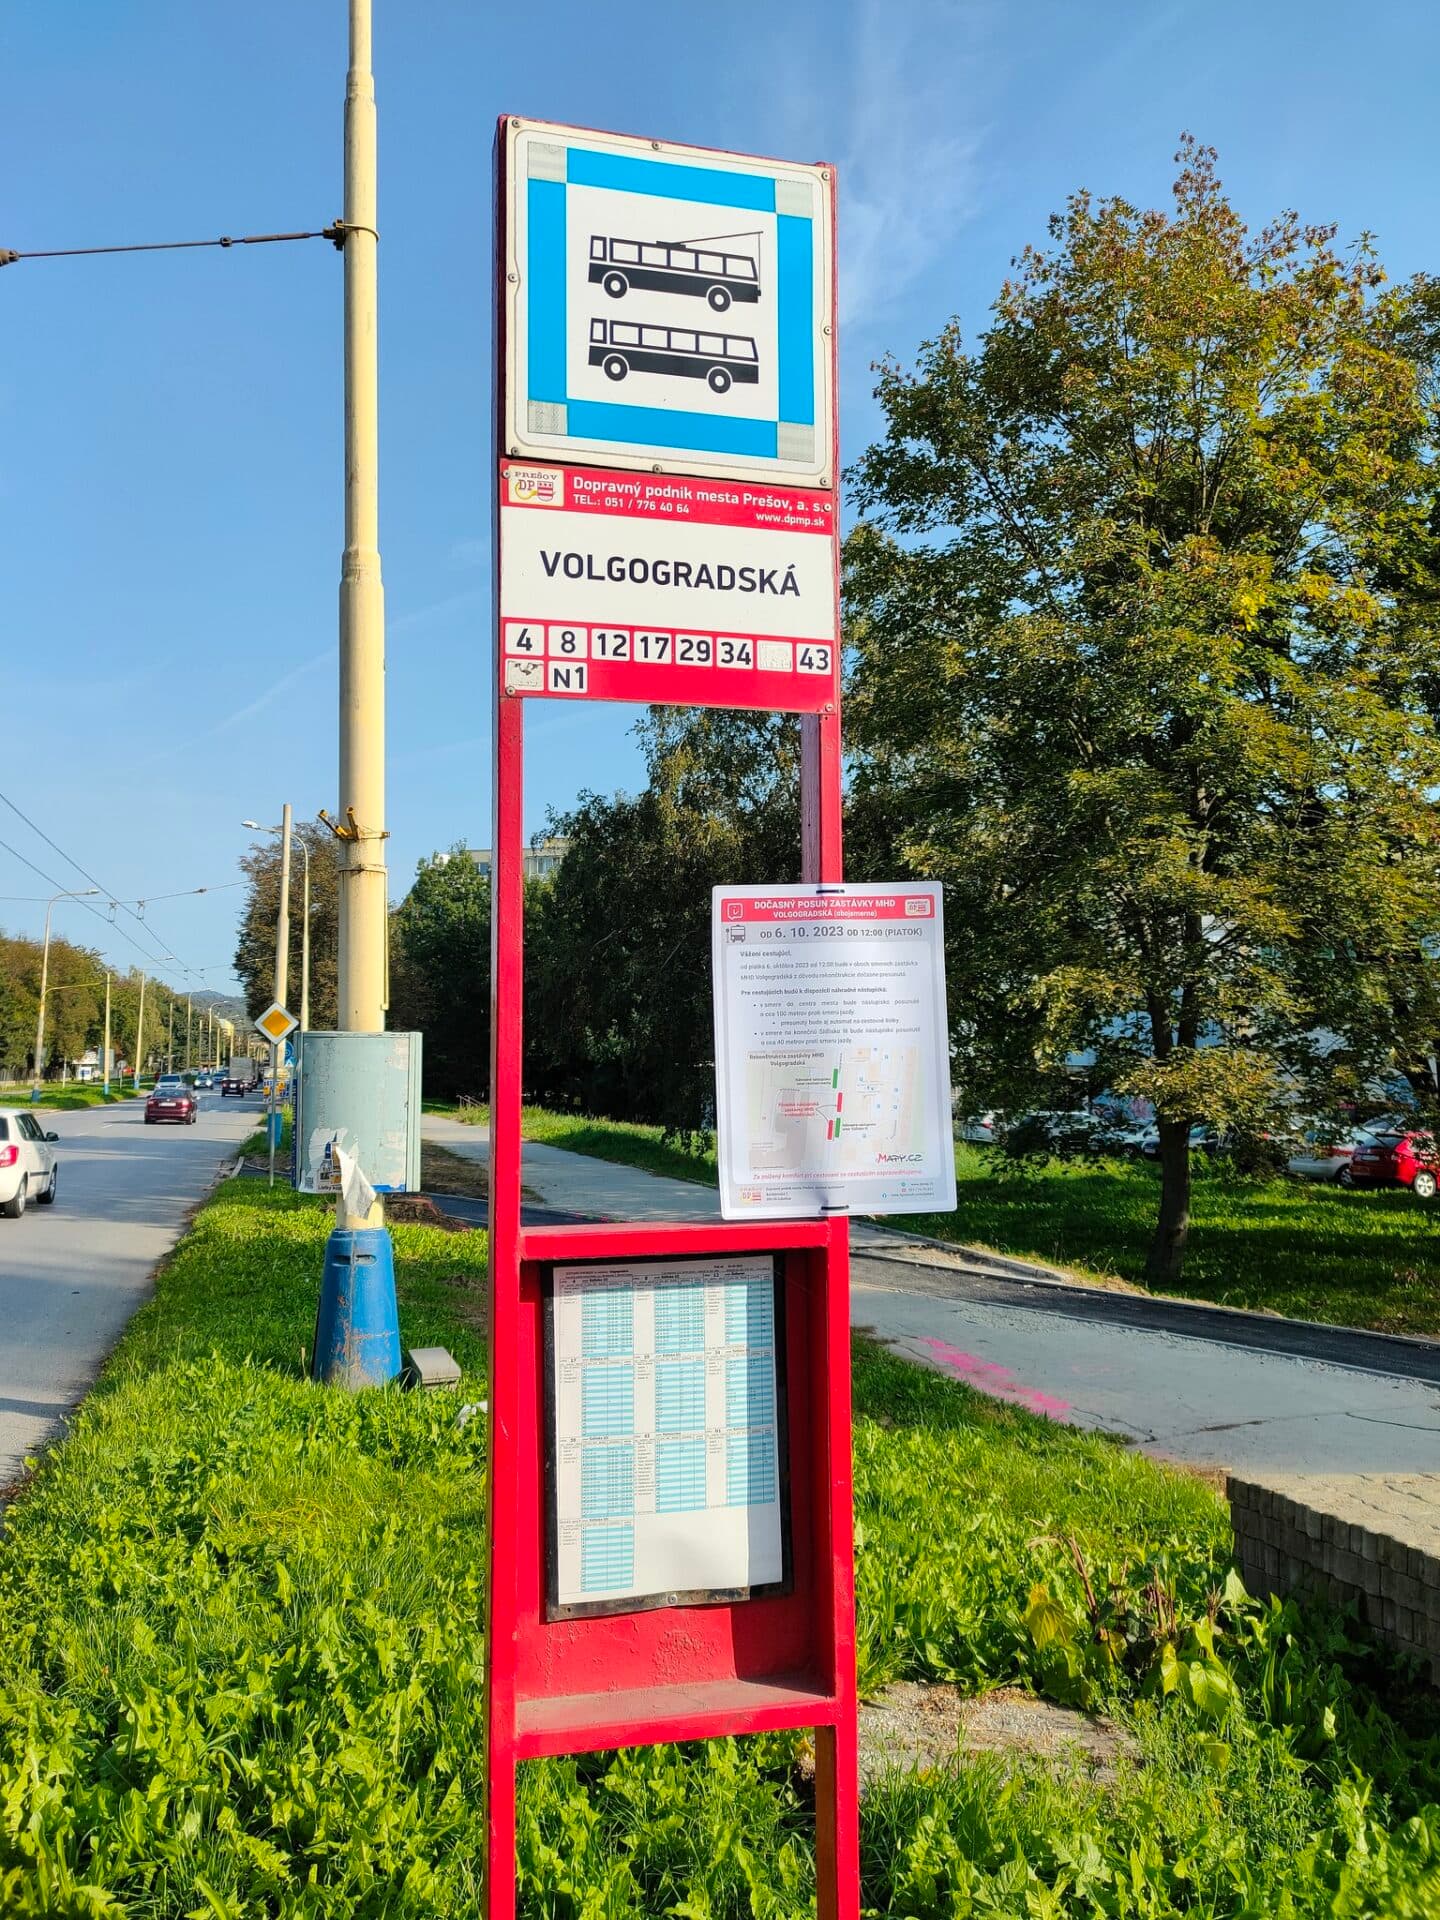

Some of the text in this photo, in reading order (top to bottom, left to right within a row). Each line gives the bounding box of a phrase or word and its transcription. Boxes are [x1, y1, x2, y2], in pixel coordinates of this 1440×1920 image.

[573, 477, 641, 498] Dopravný
[645, 484, 692, 500] podnik
[696, 490, 739, 505] mesta
[743, 493, 793, 511] Prešov,
[797, 501, 809, 511] a.
[573, 494, 690, 514] TEL.: 051 / 776 40 64
[755, 513, 825, 528] www.dpmp.sk
[540, 550, 800, 597] VOLGOGRADSKÁ
[516, 628, 829, 671] 4 8 12 17 29 34 43
[553, 666, 584, 690] N1
[754, 899, 796, 910] DOČASNÝ
[798, 899, 828, 909] POSUN
[830, 898, 873, 909] ZASTÁVKY
[876, 899, 896, 908] MHD
[773, 910, 833, 919] VOLGOGRADSKÁ
[775, 927, 786, 939] 6.
[790, 926, 809, 939] 10.
[813, 925, 845, 938] 2023
[847, 929, 859, 937] OD
[861, 929, 883, 937] 12:00
[885, 928, 923, 938] (PIATOK)
